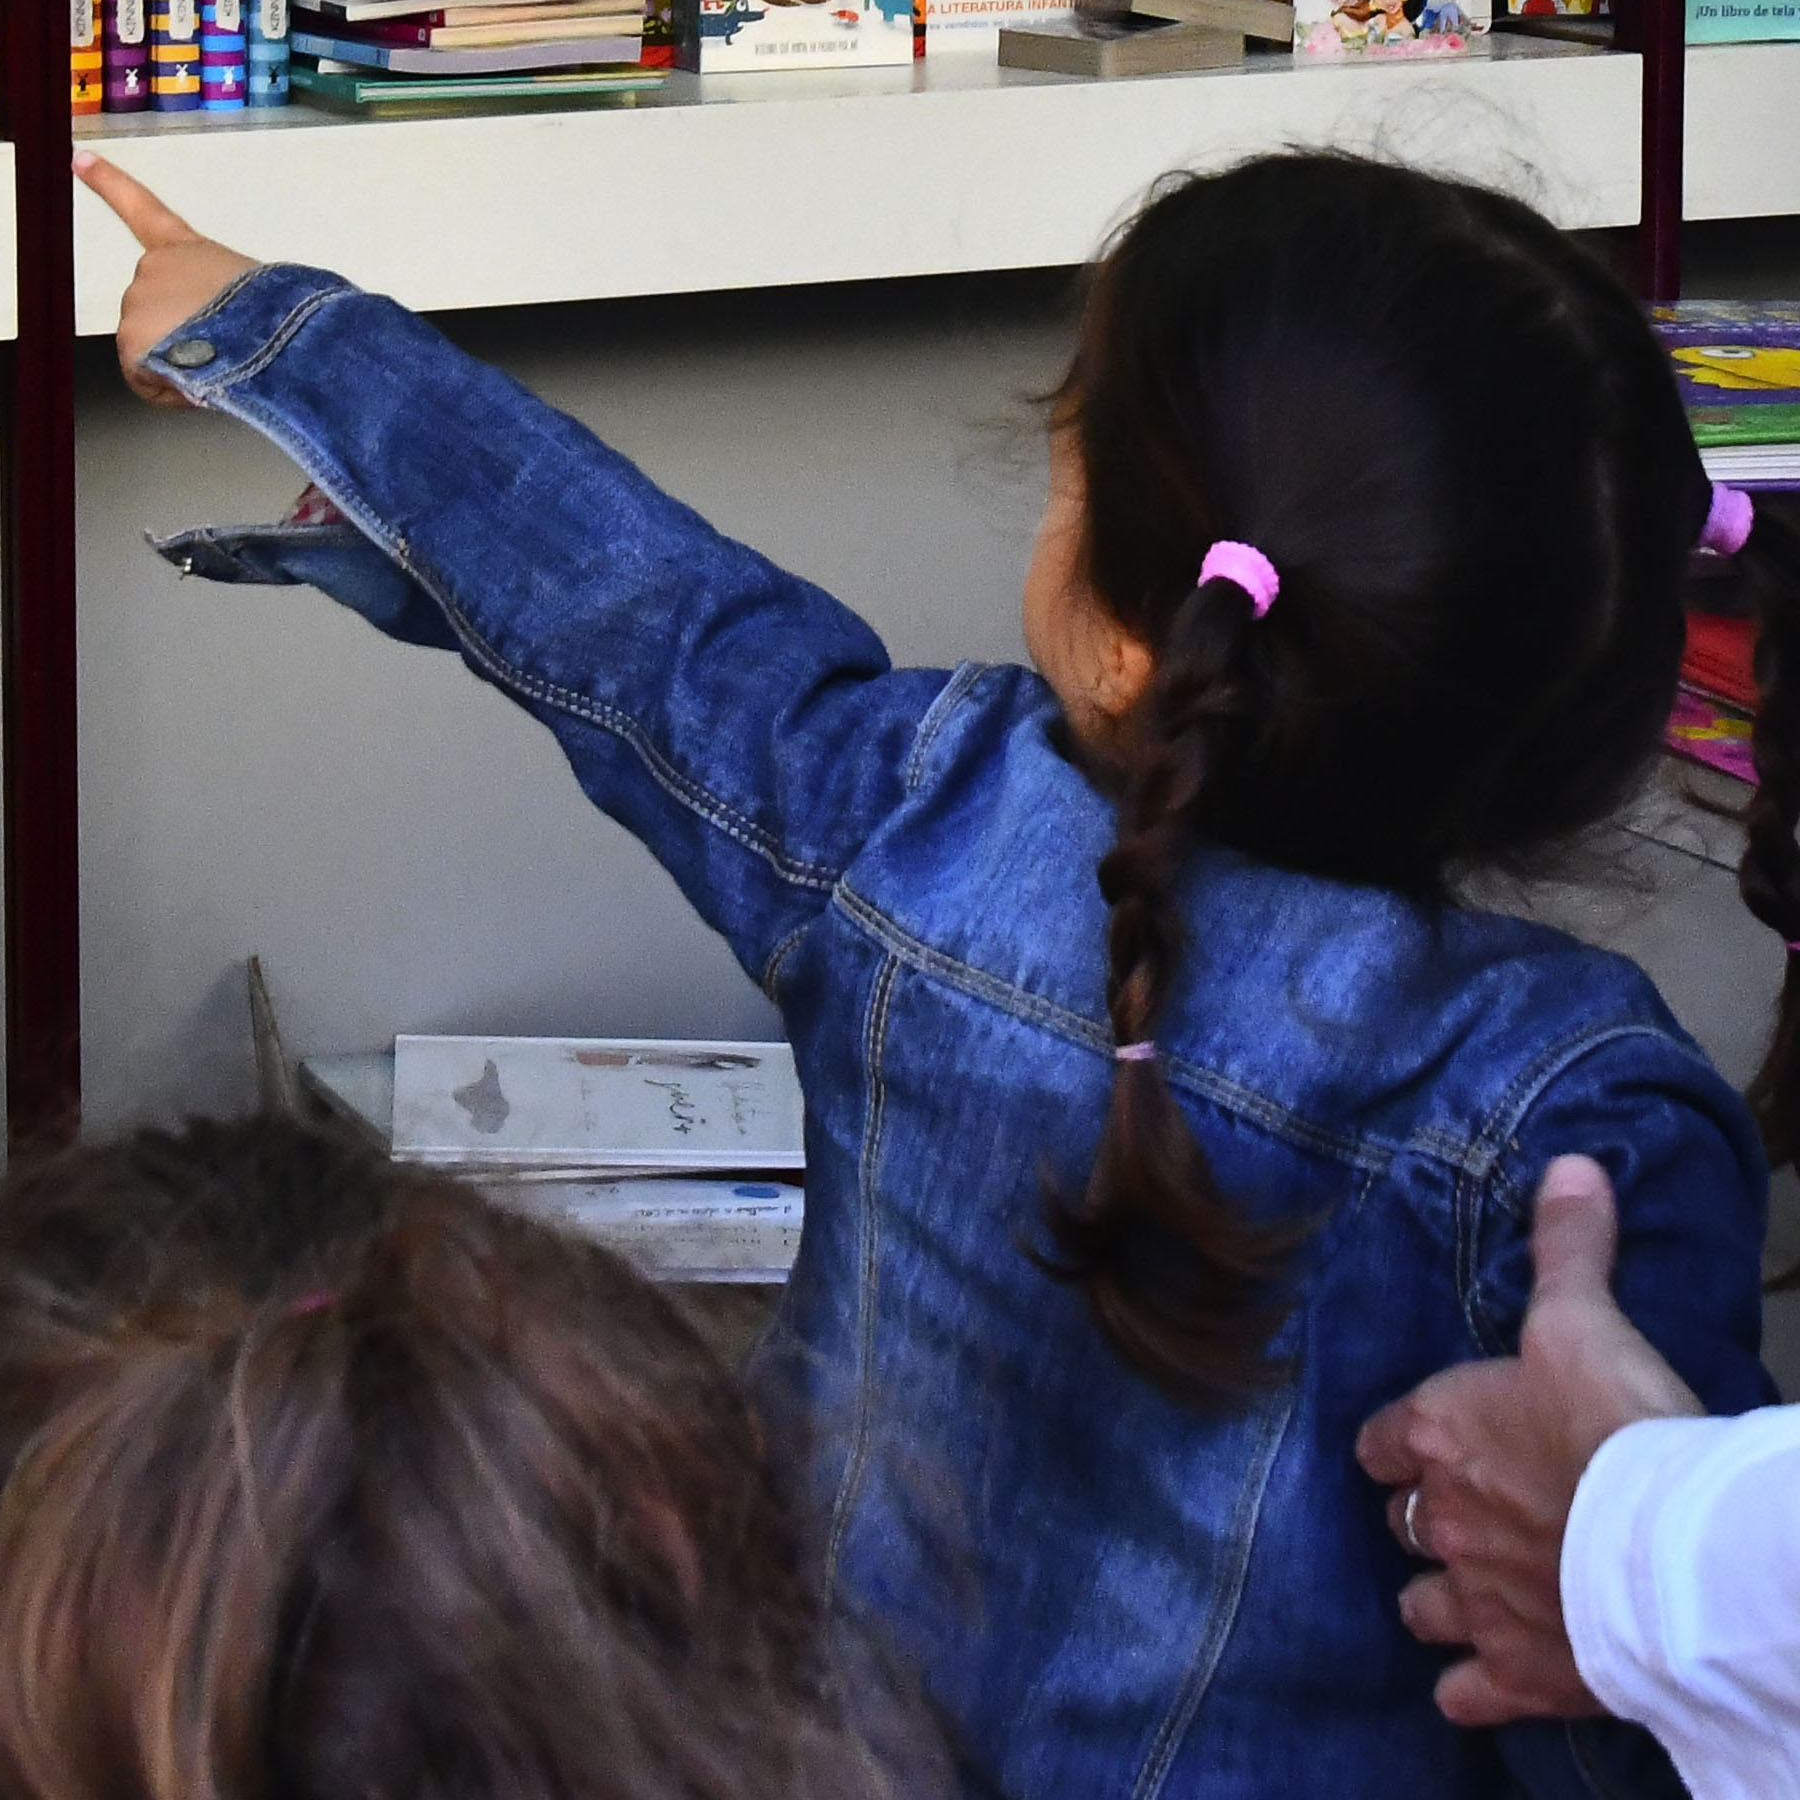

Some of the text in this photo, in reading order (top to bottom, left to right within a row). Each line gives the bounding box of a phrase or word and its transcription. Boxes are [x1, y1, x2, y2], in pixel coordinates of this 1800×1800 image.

[942, 0, 1022, 14] LITERATURA
[1722, 4, 1750, 17] libro
[1754, 4, 1769, 17] de
[1773, 5, 1794, 17] tela
